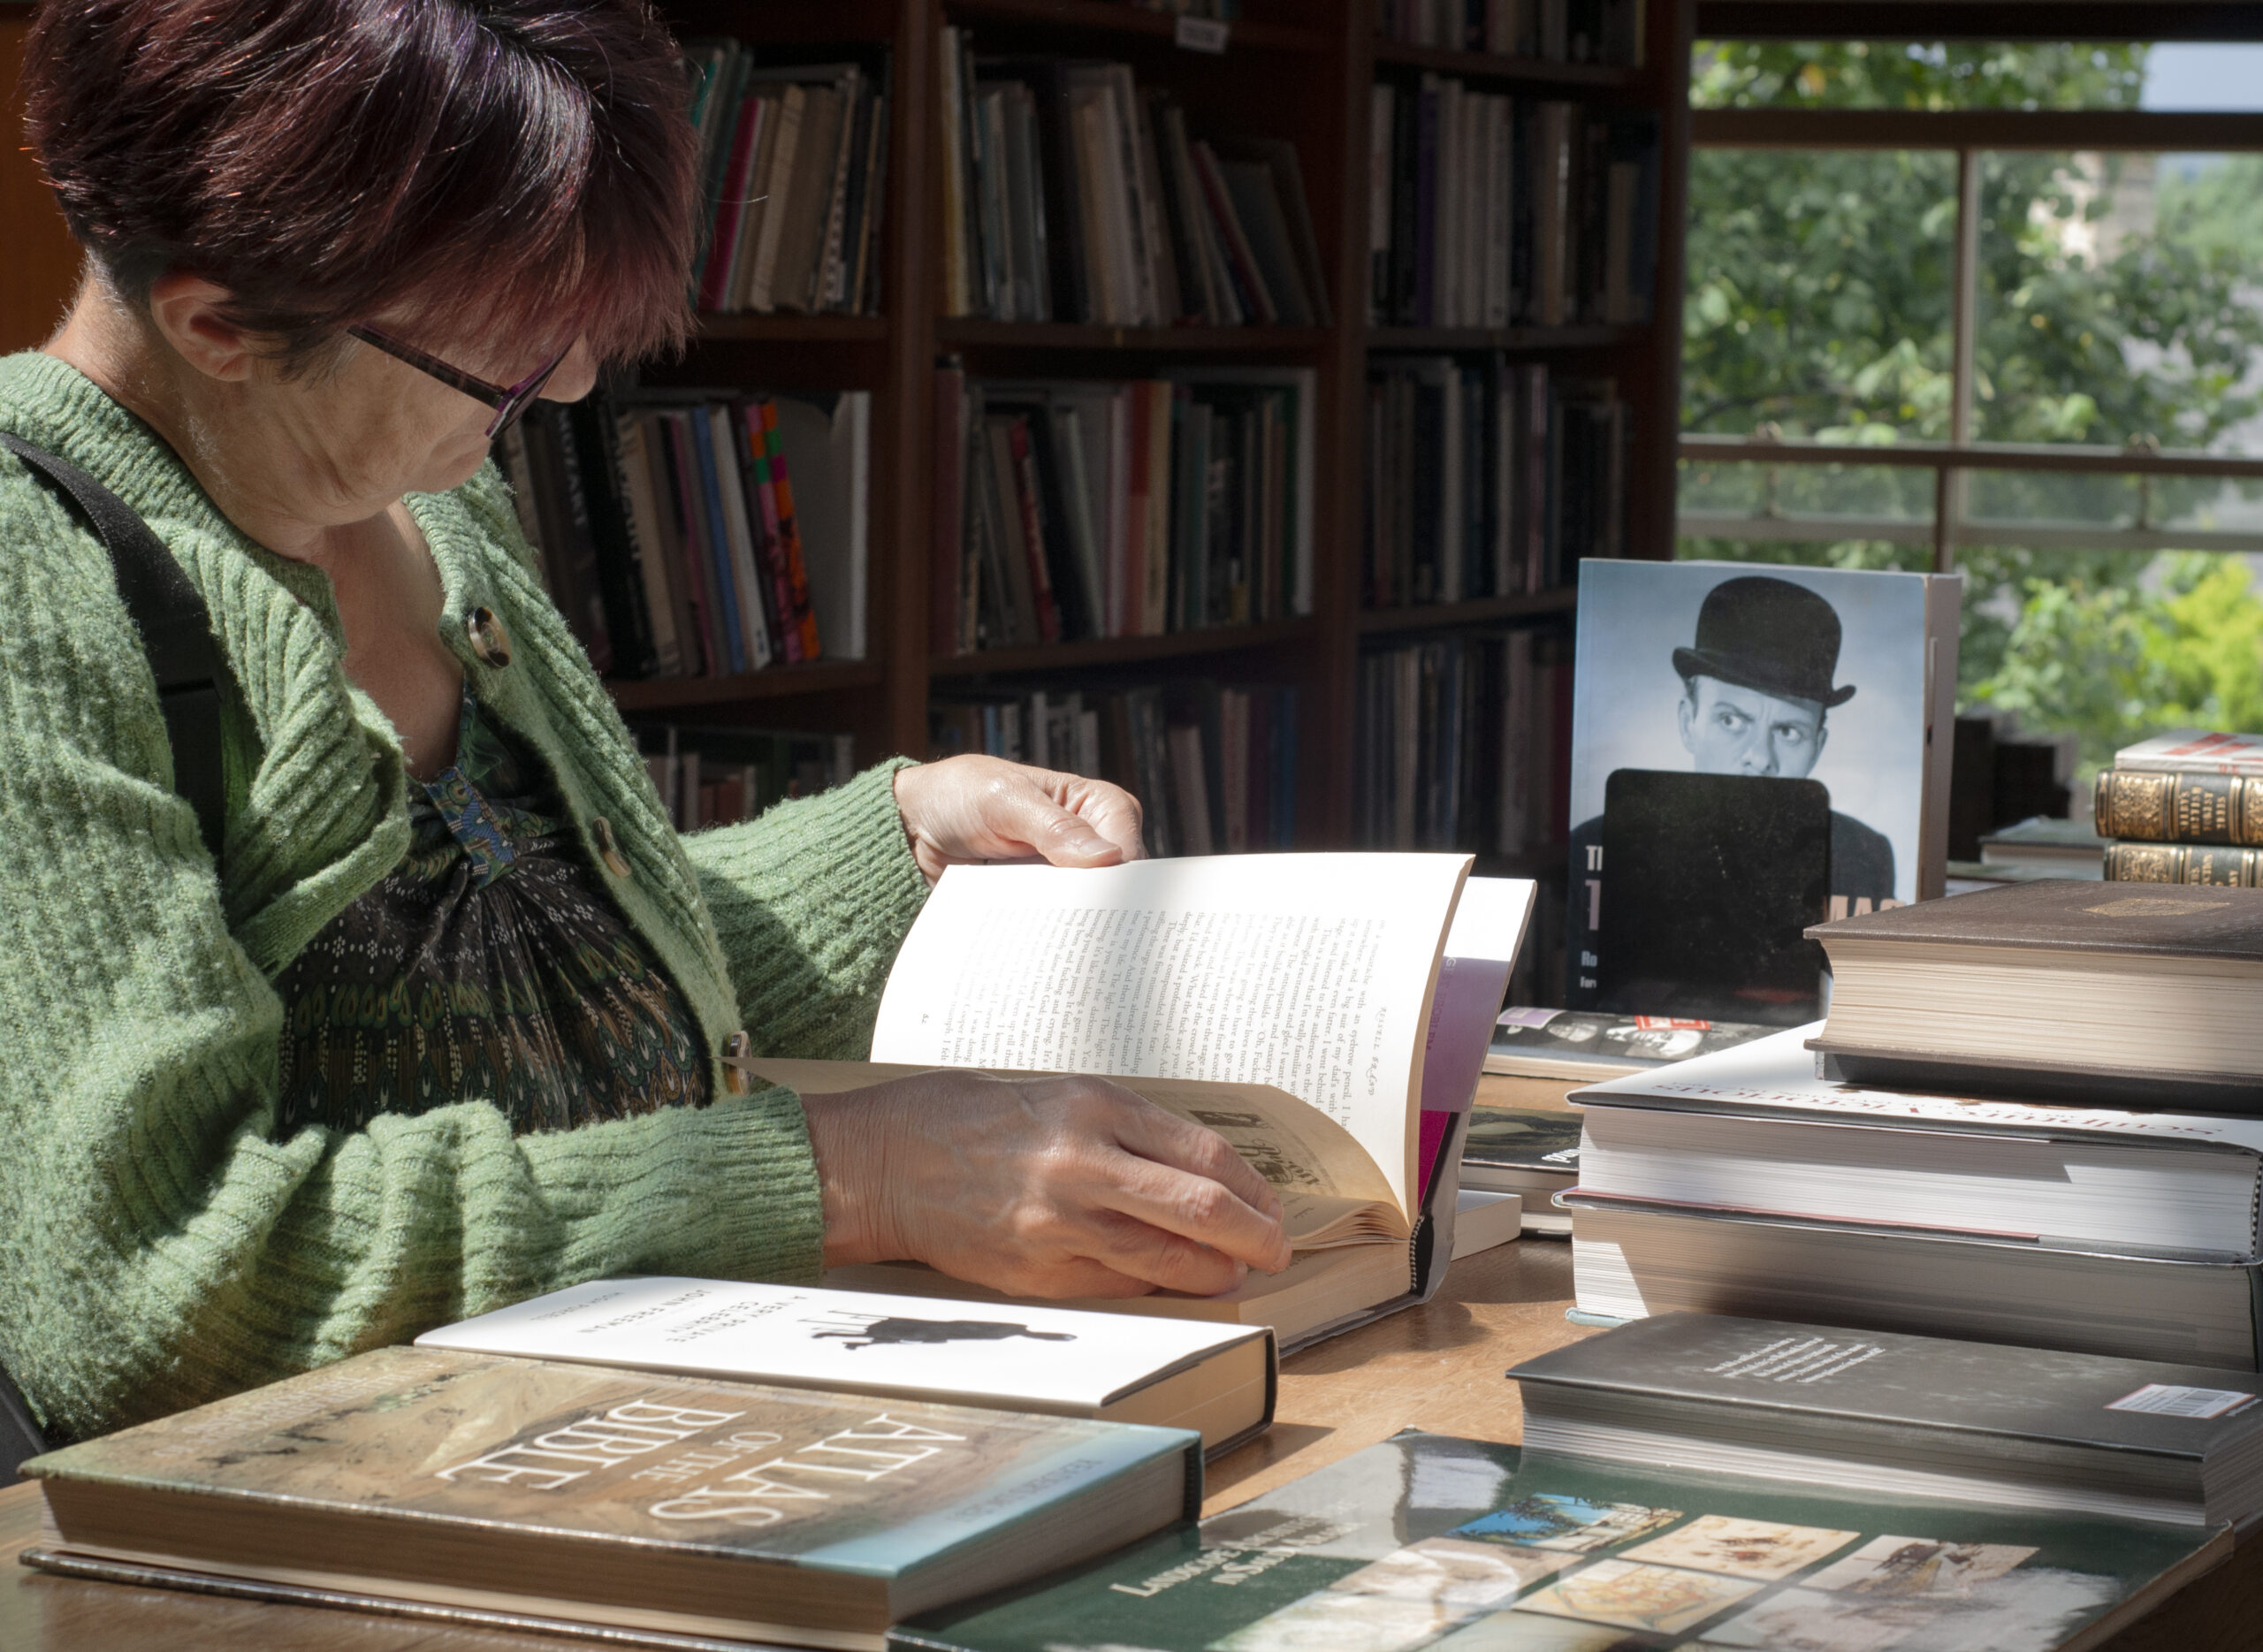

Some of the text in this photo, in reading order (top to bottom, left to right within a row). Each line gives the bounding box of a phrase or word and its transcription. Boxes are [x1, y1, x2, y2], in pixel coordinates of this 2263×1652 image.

[1084, 909, 1107, 938] knowing
[1079, 940, 1091, 952] you
[1147, 935, 1160, 947] the
[1329, 942, 1341, 955] and
[1074, 955, 1087, 974] must
[1139, 949, 1152, 965] urge
[1065, 976, 1078, 997] jump.
[1162, 943, 1196, 1031] violated professional
[1198, 972, 1213, 998] looked
[1261, 950, 1285, 1018] builds and builds
[1320, 959, 1337, 989] listened
[1028, 981, 1040, 1002] knew
[1043, 930, 1085, 1045] born and fucking and crying.
[1071, 946, 1103, 1045] It's like holding gun or
[1093, 939, 1130, 1057] my light
[1131, 920, 1178, 1074] There was five minutes standing
[1147, 939, 1184, 1054] but compounded the fear.
[1235, 978, 1250, 1001] going
[1012, 998, 1023, 1016] been
[1031, 953, 1063, 1054] alone with you taste
[1081, 950, 1113, 1068] you and the darkness. You
[1109, 965, 1136, 1056] And then walked out
[1182, 1001, 1192, 1014] the
[1234, 1005, 1245, 1014] to
[1242, 961, 1269, 1047] there living their lives
[1277, 935, 1317, 1078] mingled excitement and want
[1292, 929, 1332, 1077] This that I'm really familiar
[1314, 1005, 1324, 1018] the
[984, 1007, 993, 1028] never
[1007, 1020, 1016, 1031] up
[1061, 1010, 1071, 1028] feels
[1123, 1003, 1139, 1032] already
[1177, 1016, 1188, 1034] fuck
[1192, 1012, 1203, 1025] the
[1197, 981, 1223, 1065] went up to the stage
[1215, 987, 1235, 1050] where that first
[1231, 1017, 1241, 1036] have
[1262, 972, 1292, 1074] anticipation and anxiety
[1315, 950, 1352, 1103] make me even went behind
[1345, 989, 1369, 1066] with an eyebrow
[964, 1038, 975, 1062] doing
[993, 1032, 1002, 1054] know
[1019, 1029, 1029, 1047] alive
[1057, 1032, 1067, 1050] slow
[1120, 1034, 1132, 1066] drained
[1187, 1028, 1200, 1057] crowd.
[1307, 1022, 1322, 1060] audience
[1329, 968, 1360, 1113] and big suit of my dad's with
[1055, 1053, 1063, 1068] and
[1170, 1053, 1179, 1069] you
[1185, 1060, 1194, 1075] Mr
[1223, 1053, 1232, 1063] go
[1305, 1063, 1312, 1074] on
[1303, 1078, 1313, 1092] the
[661, 1288, 712, 1306] JOHN
[748, 1300, 792, 1318] VERY
[575, 1306, 666, 1334] FREEMAN
[663, 1300, 759, 1334] CELEBRITY
[665, 1317, 748, 1343] PRIVATE
[433, 1398, 748, 1492] BIBLE
[629, 1429, 784, 1484] OF THE
[647, 1412, 967, 1528] ATLAS
[1109, 1549, 1242, 1598] LANDSCAPE
